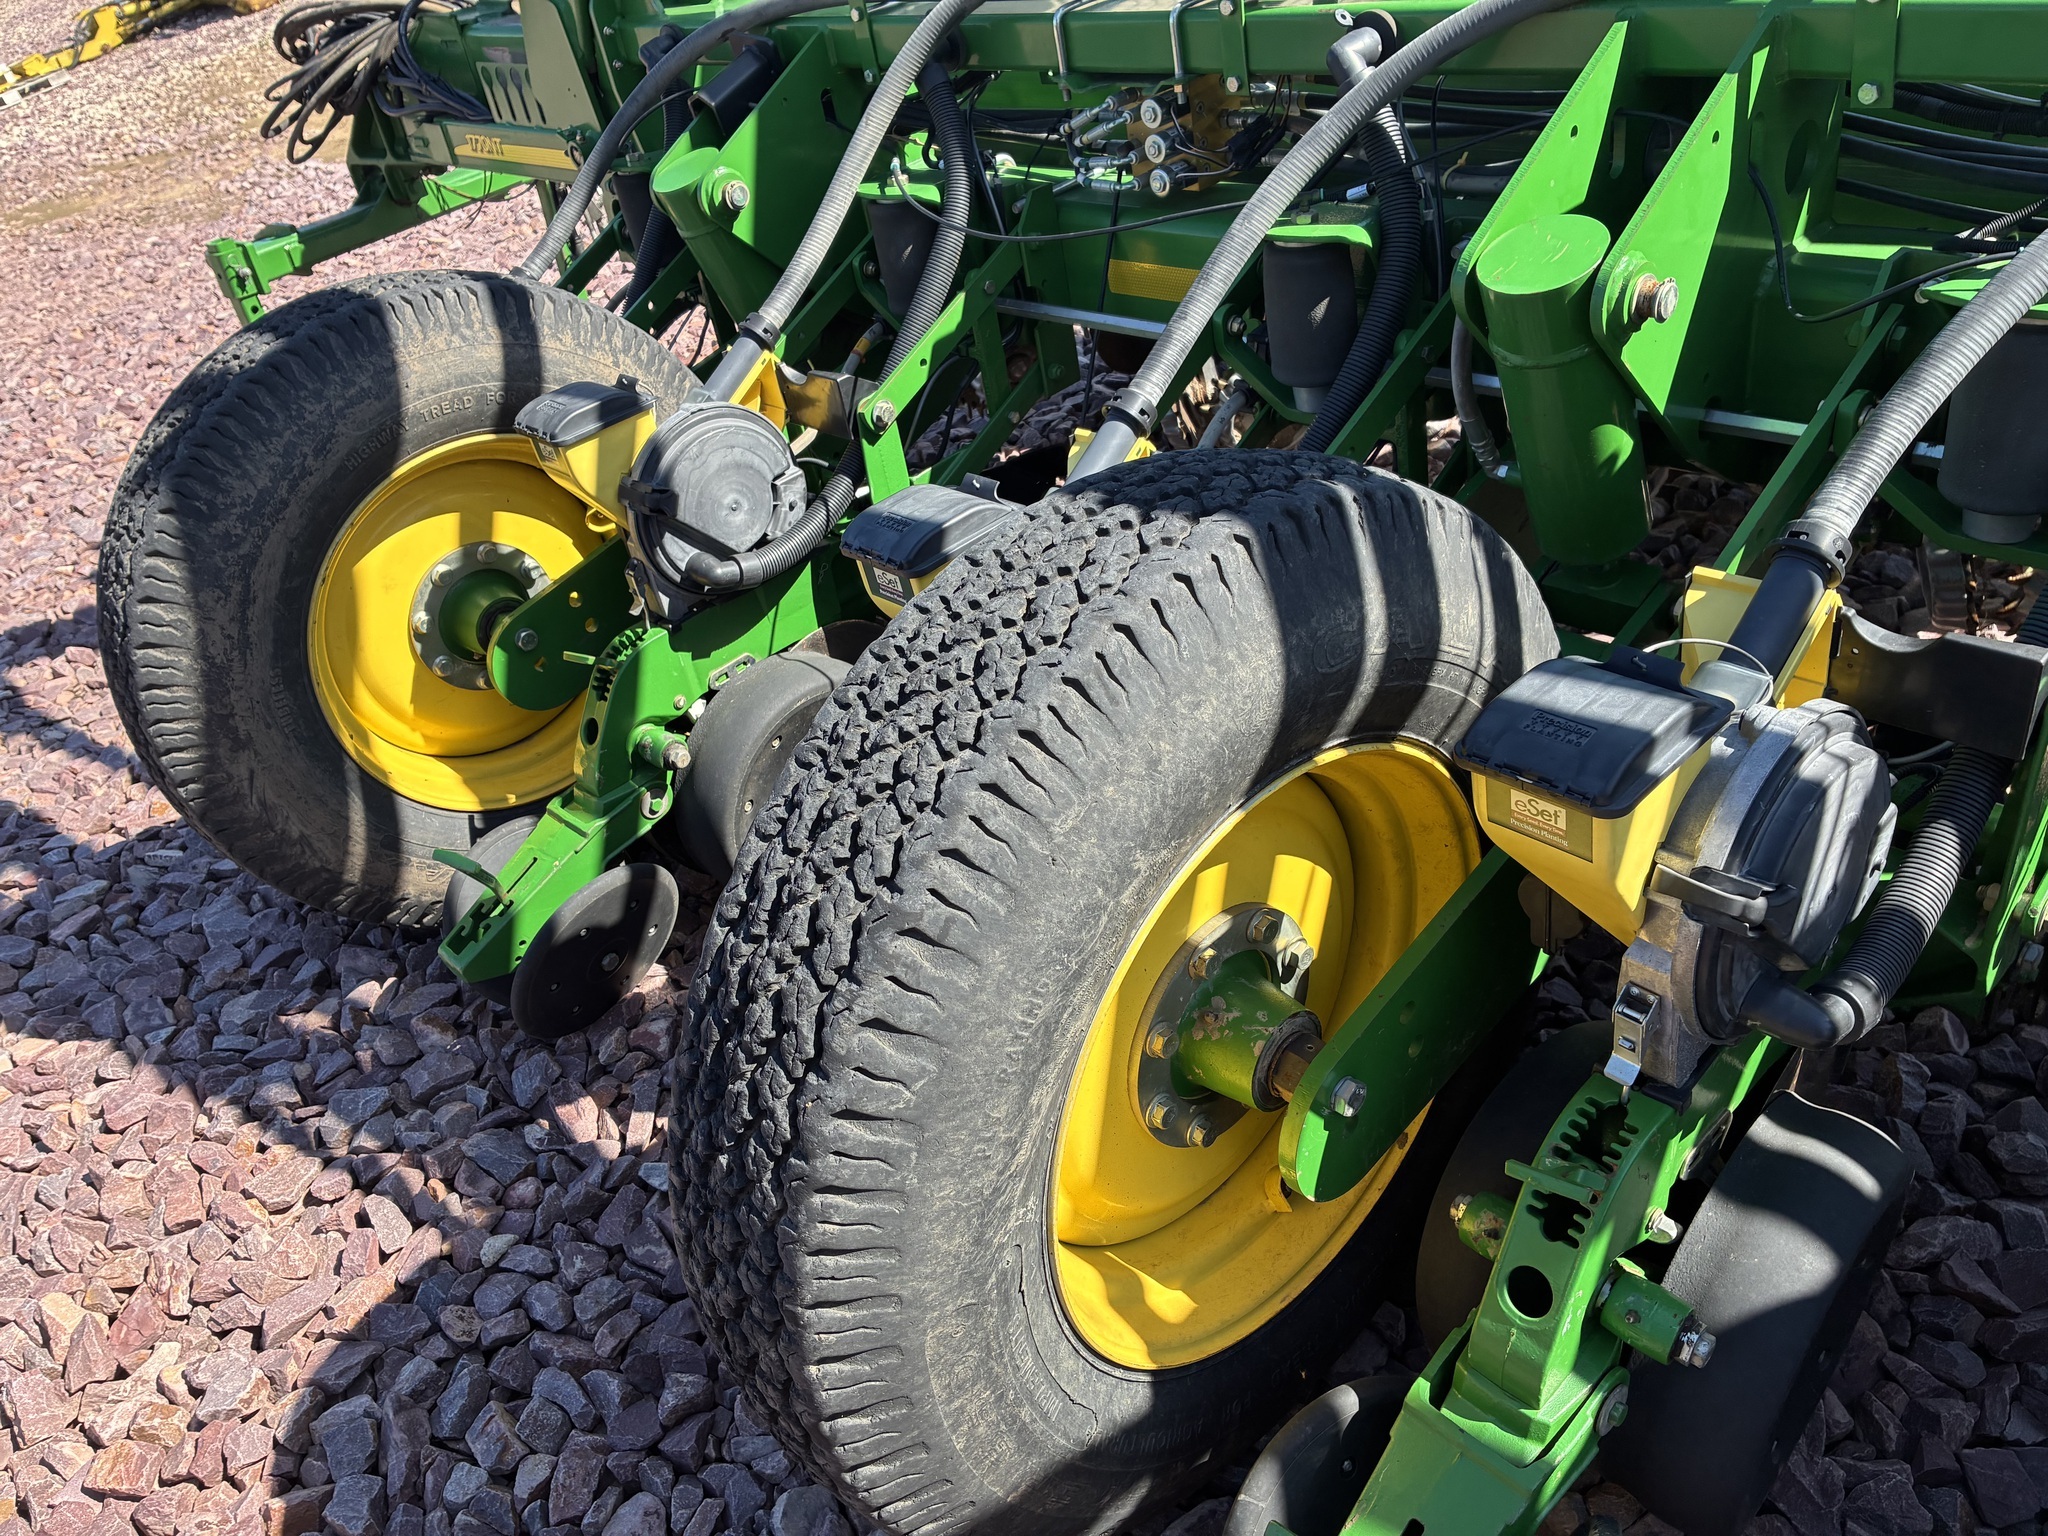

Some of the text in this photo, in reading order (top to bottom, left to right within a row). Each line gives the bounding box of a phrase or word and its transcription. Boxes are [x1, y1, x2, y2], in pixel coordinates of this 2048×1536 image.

[344, 417, 410, 471] HIGHWAY
[420, 396, 475, 422] TREAD
[486, 391, 516, 406] FOR
[877, 572, 899, 590] eSet
[1532, 711, 1593, 738] Precision
[1514, 798, 1560, 826] eSet
[1511, 818, 1569, 847] Precision Planting
